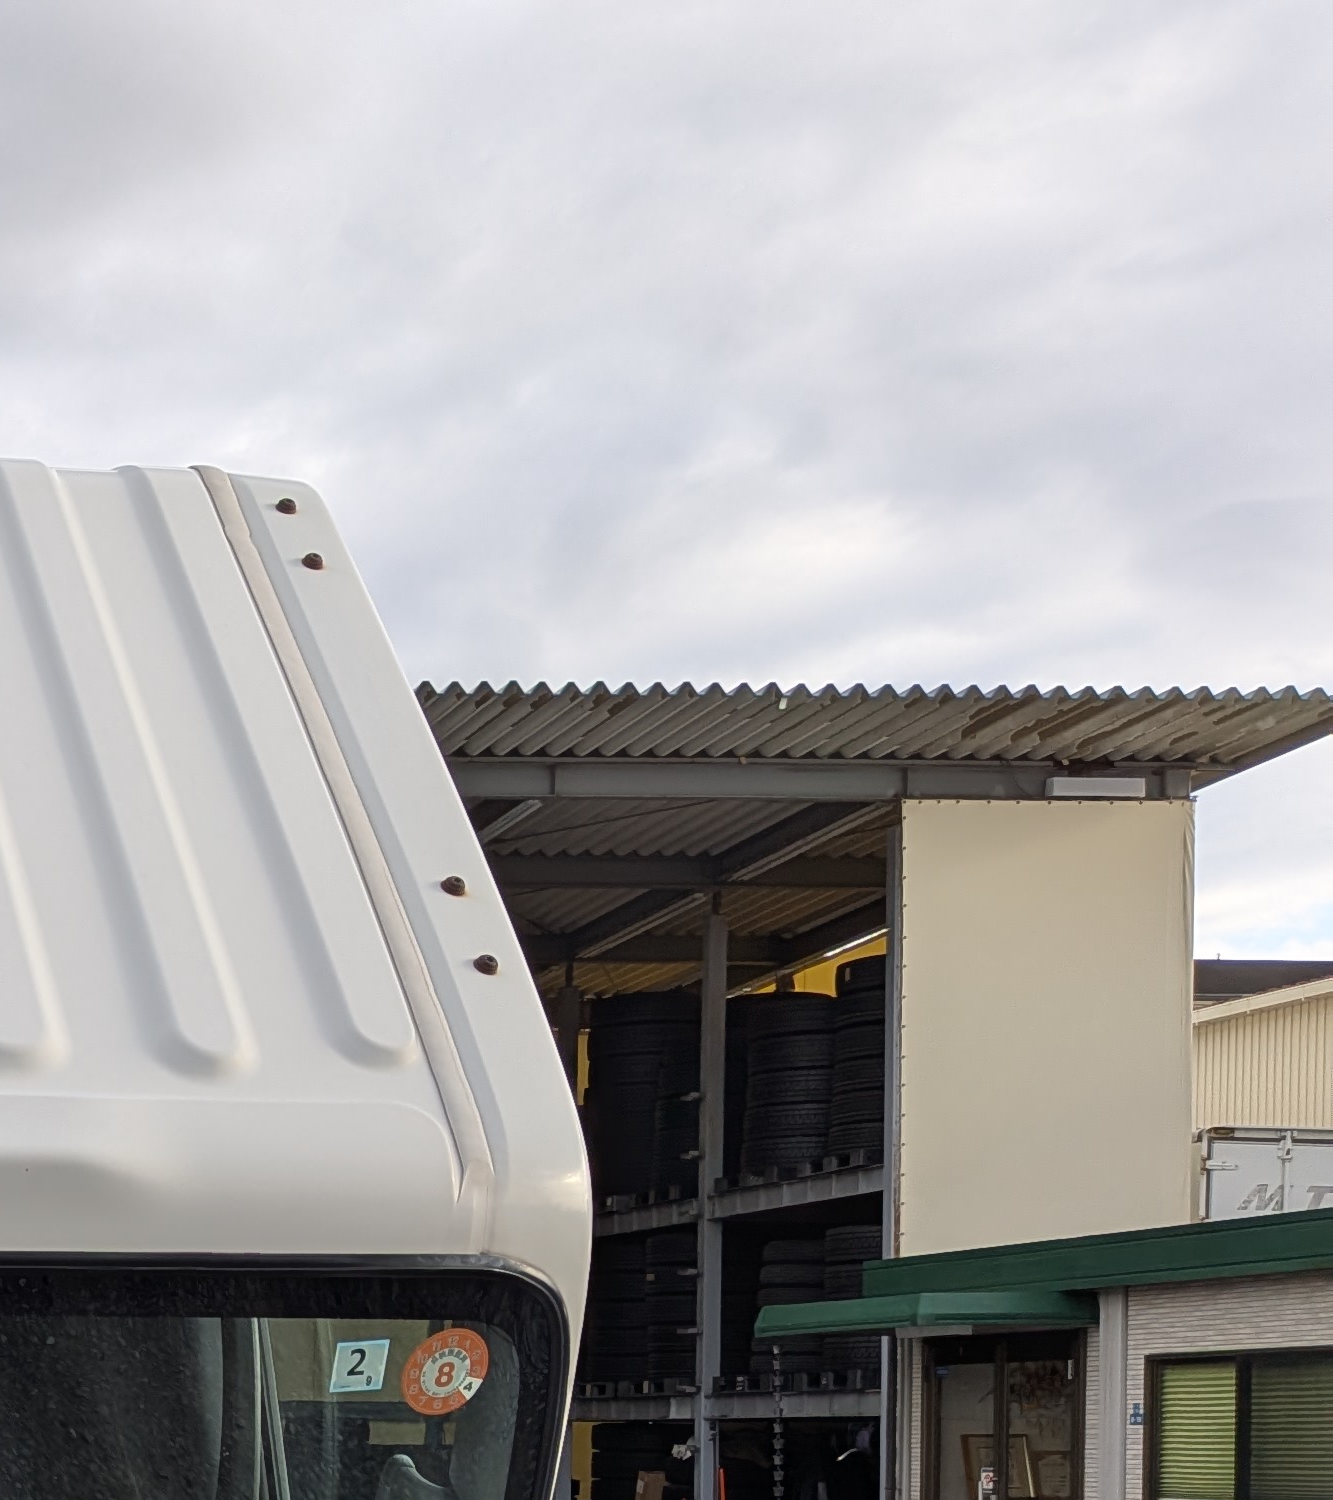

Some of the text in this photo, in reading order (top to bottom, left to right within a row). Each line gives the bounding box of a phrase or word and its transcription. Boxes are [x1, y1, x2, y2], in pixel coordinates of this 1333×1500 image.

[347, 1348, 367, 1377] 2
[365, 1375, 373, 1387] 9
[434, 1362, 455, 1388] 8
[463, 1381, 474, 1393] 4
